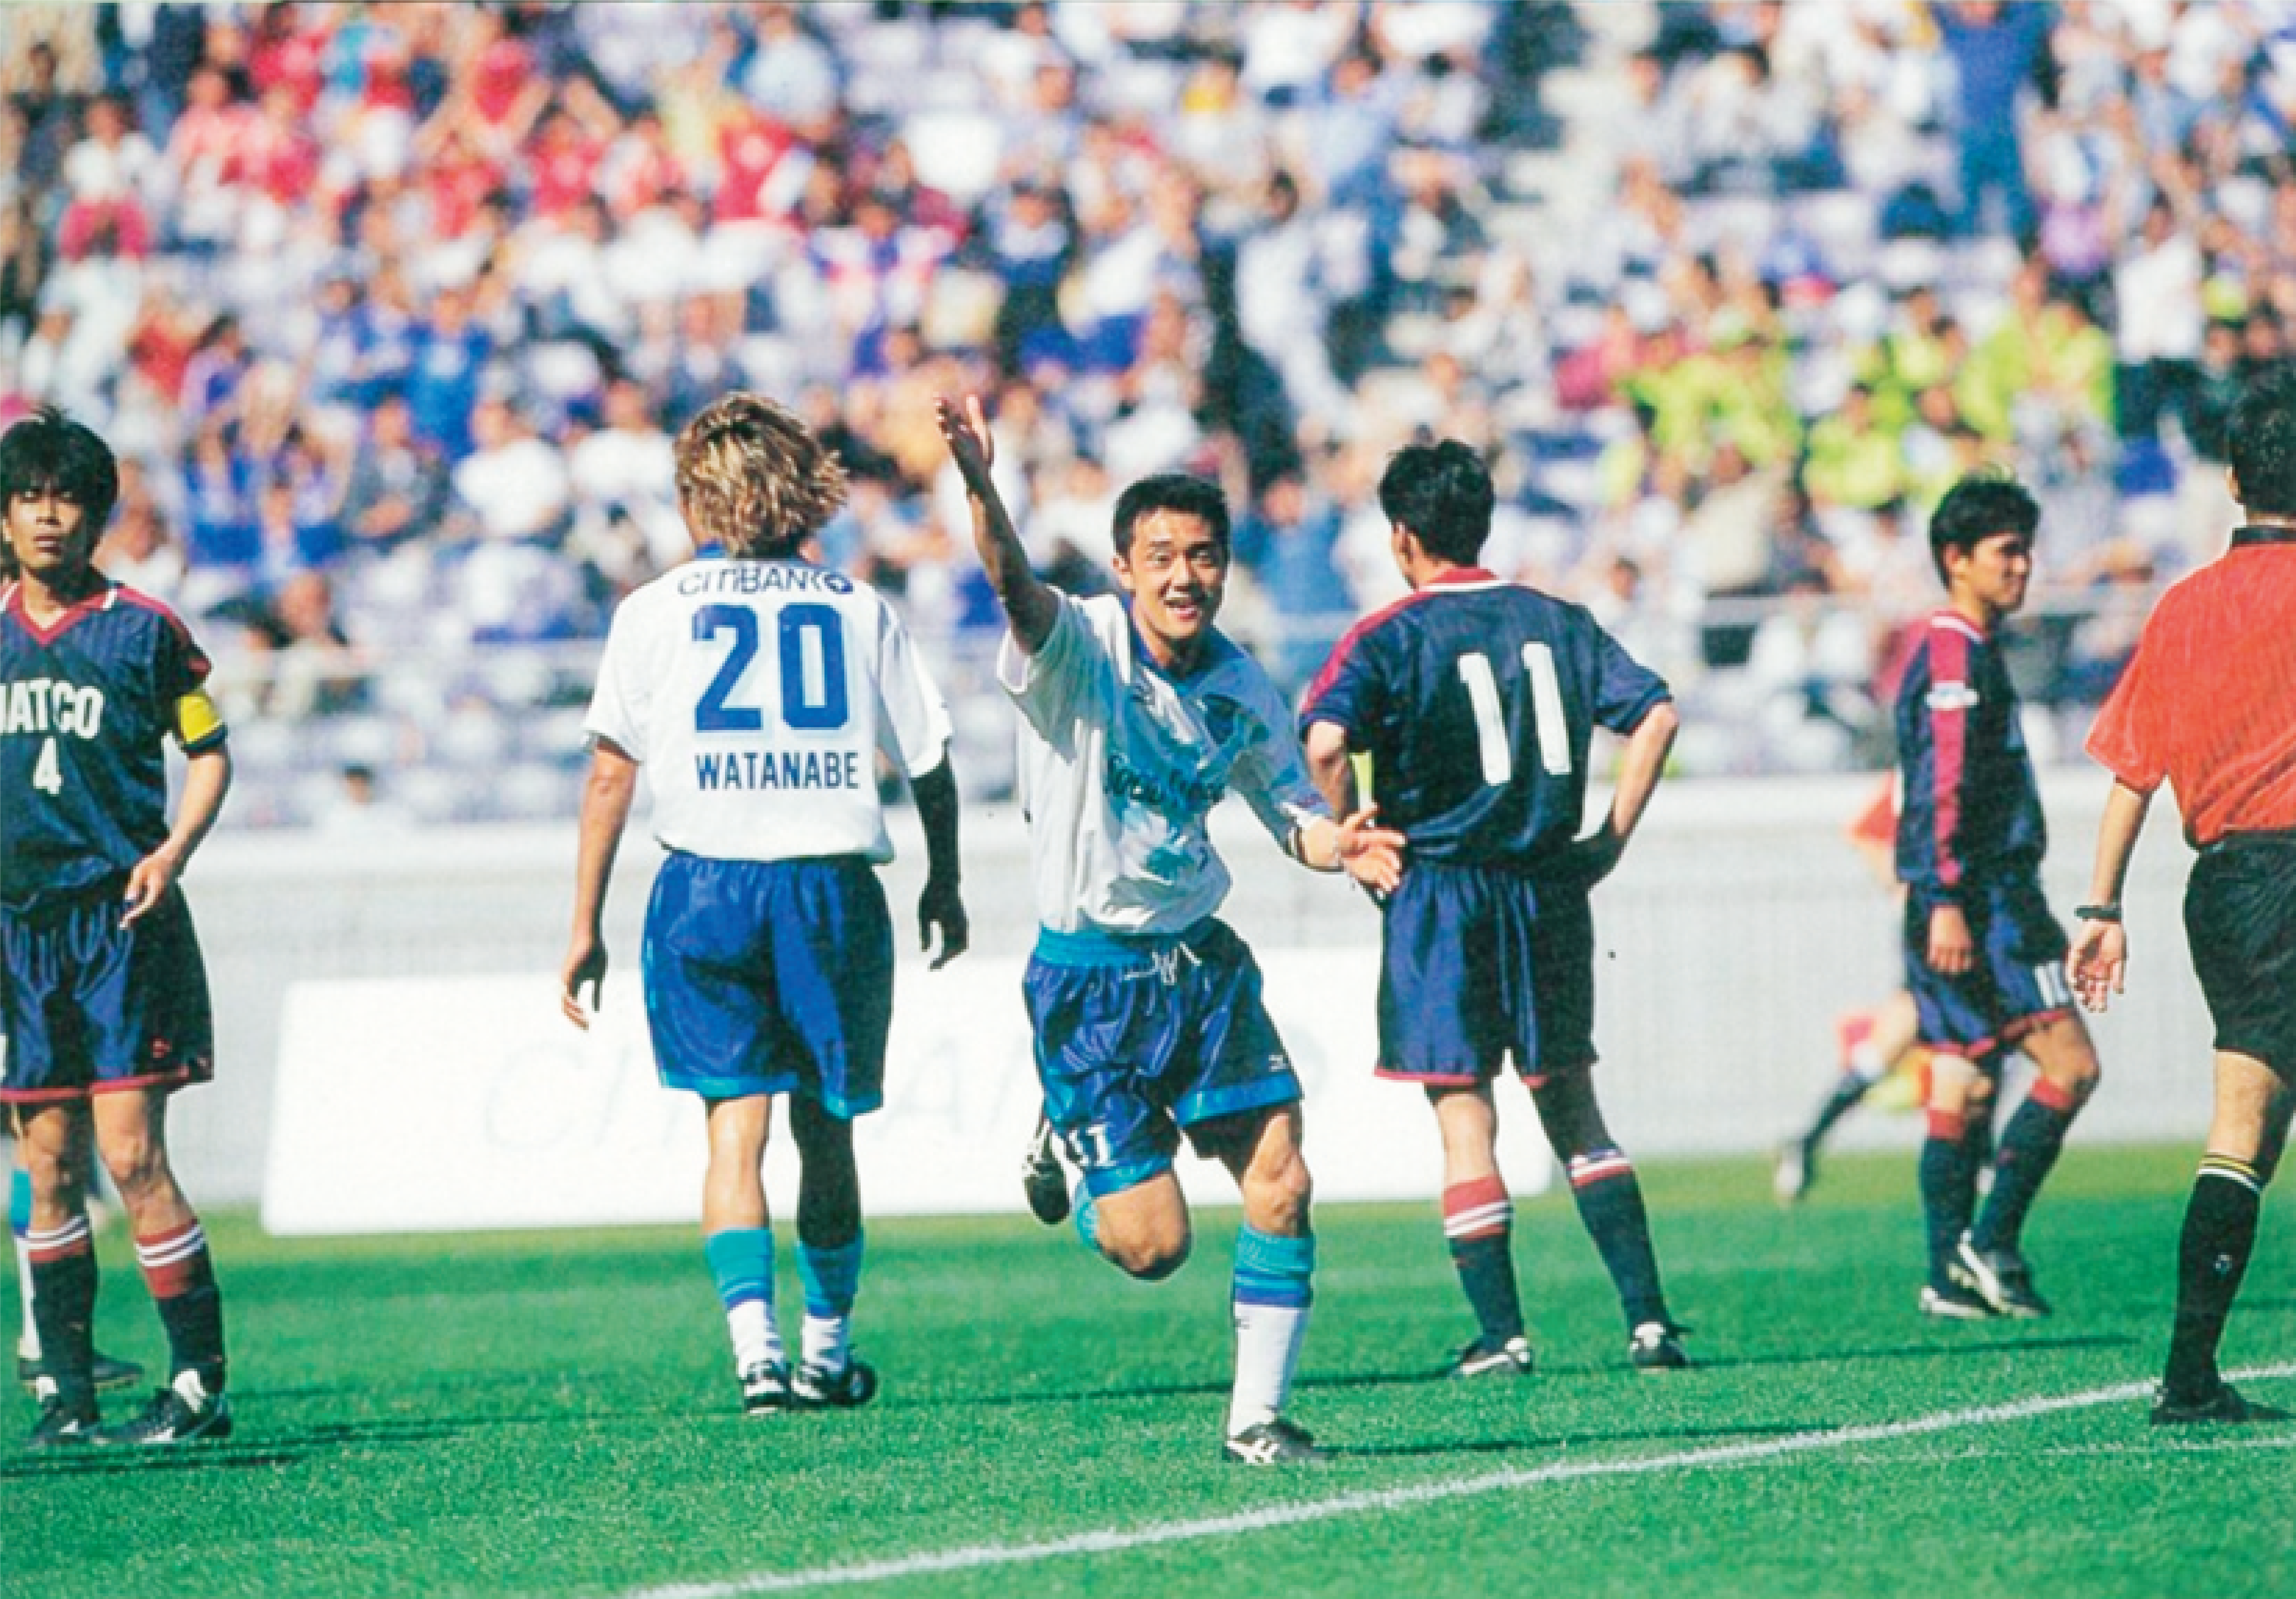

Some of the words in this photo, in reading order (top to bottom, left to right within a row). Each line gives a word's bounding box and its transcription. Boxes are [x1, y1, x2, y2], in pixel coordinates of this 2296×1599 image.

[692, 602, 849, 733] 20
[0, 678, 105, 739] ATCO
[1457, 641, 1572, 786] 11
[33, 736, 64, 794] 4
[695, 750, 859, 790] WATANABE
